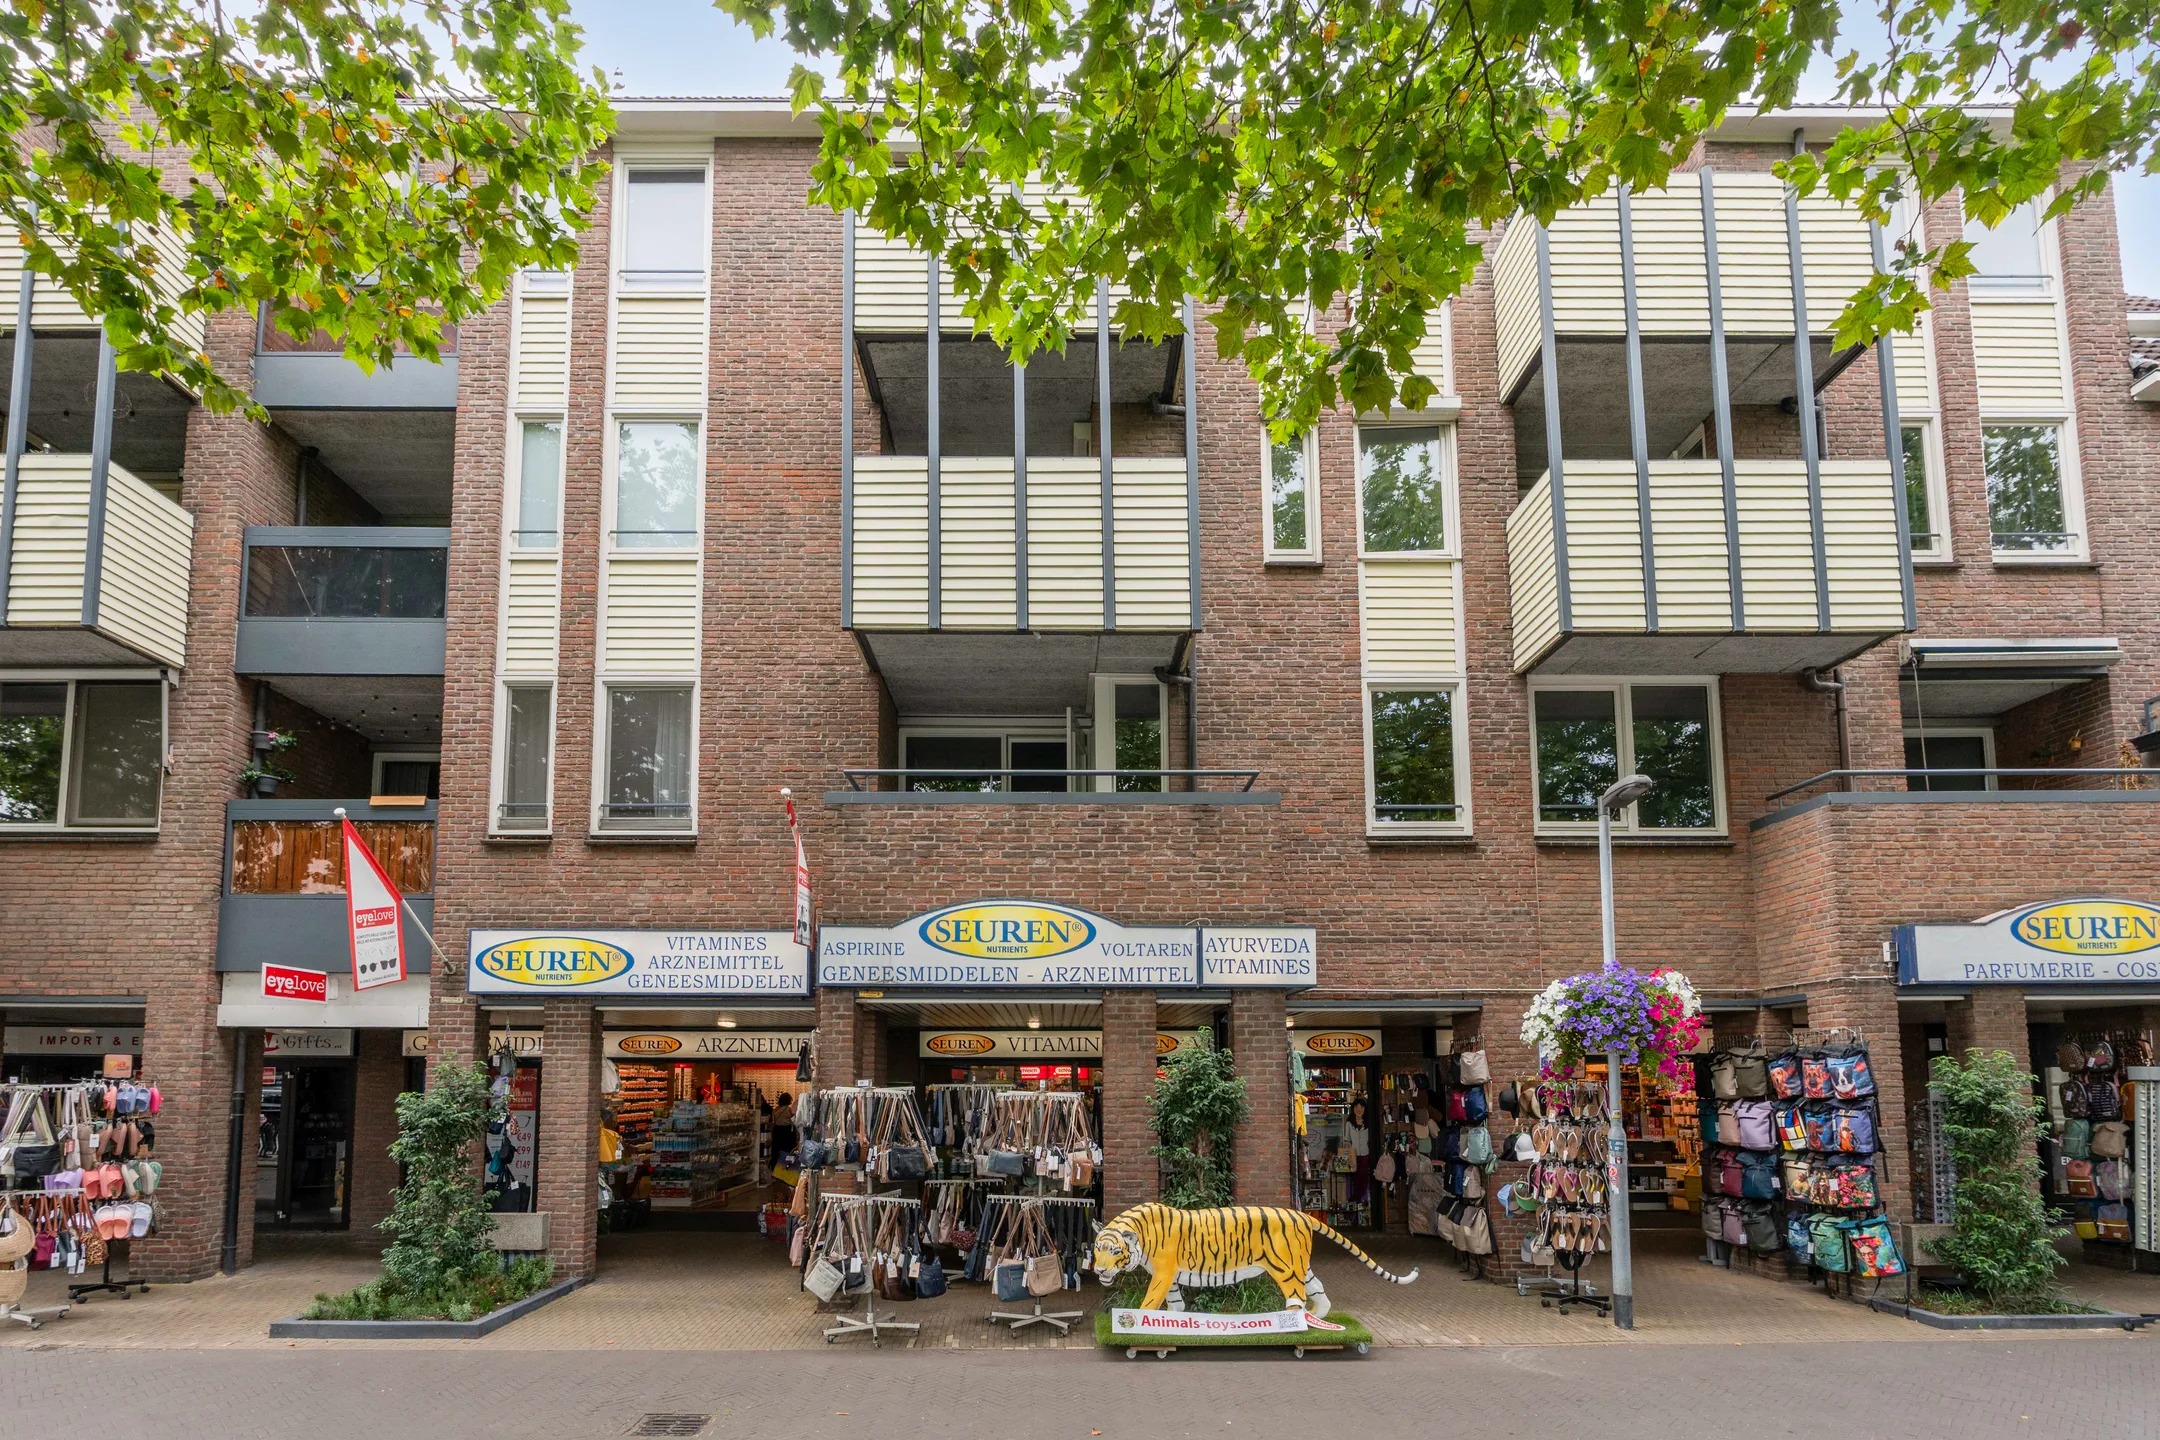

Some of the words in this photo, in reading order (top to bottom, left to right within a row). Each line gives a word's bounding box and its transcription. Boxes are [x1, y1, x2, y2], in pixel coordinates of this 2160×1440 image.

[356, 909, 395, 927] eyelove
[667, 936, 767, 951] VITAMINES
[823, 942, 905, 956] ASPIRINE
[986, 945, 1028, 954] NUTRIENTS
[1100, 943, 1193, 957] VOLTAREN
[1205, 937, 1311, 954] AYURVEDA
[2077, 942, 2118, 950] NUTRIENTS
[648, 955, 784, 970] ARZNEIMITTEL
[1205, 958, 1311, 975] VITAMINES
[535, 973, 573, 981] NUTRIENTS
[823, 966, 1019, 983] GENEESMIDDELEN
[1041, 966, 1194, 983] ARZNEIMITTEL
[1964, 963, 2095, 979] PARFUMERIE
[2116, 962, 2160, 978] COS
[266, 974, 325, 993] eyelove
[627, 974, 804, 989] GENEESMIDDELEN
[40, 1036, 103, 1046] IMPORT
[695, 1037, 811, 1053] ARZNEIMI
[1006, 1036, 1101, 1052] VITAMIN
[515, 1160, 531, 1169] €149
[1141, 1315, 1272, 1332] Animals-toys.com
